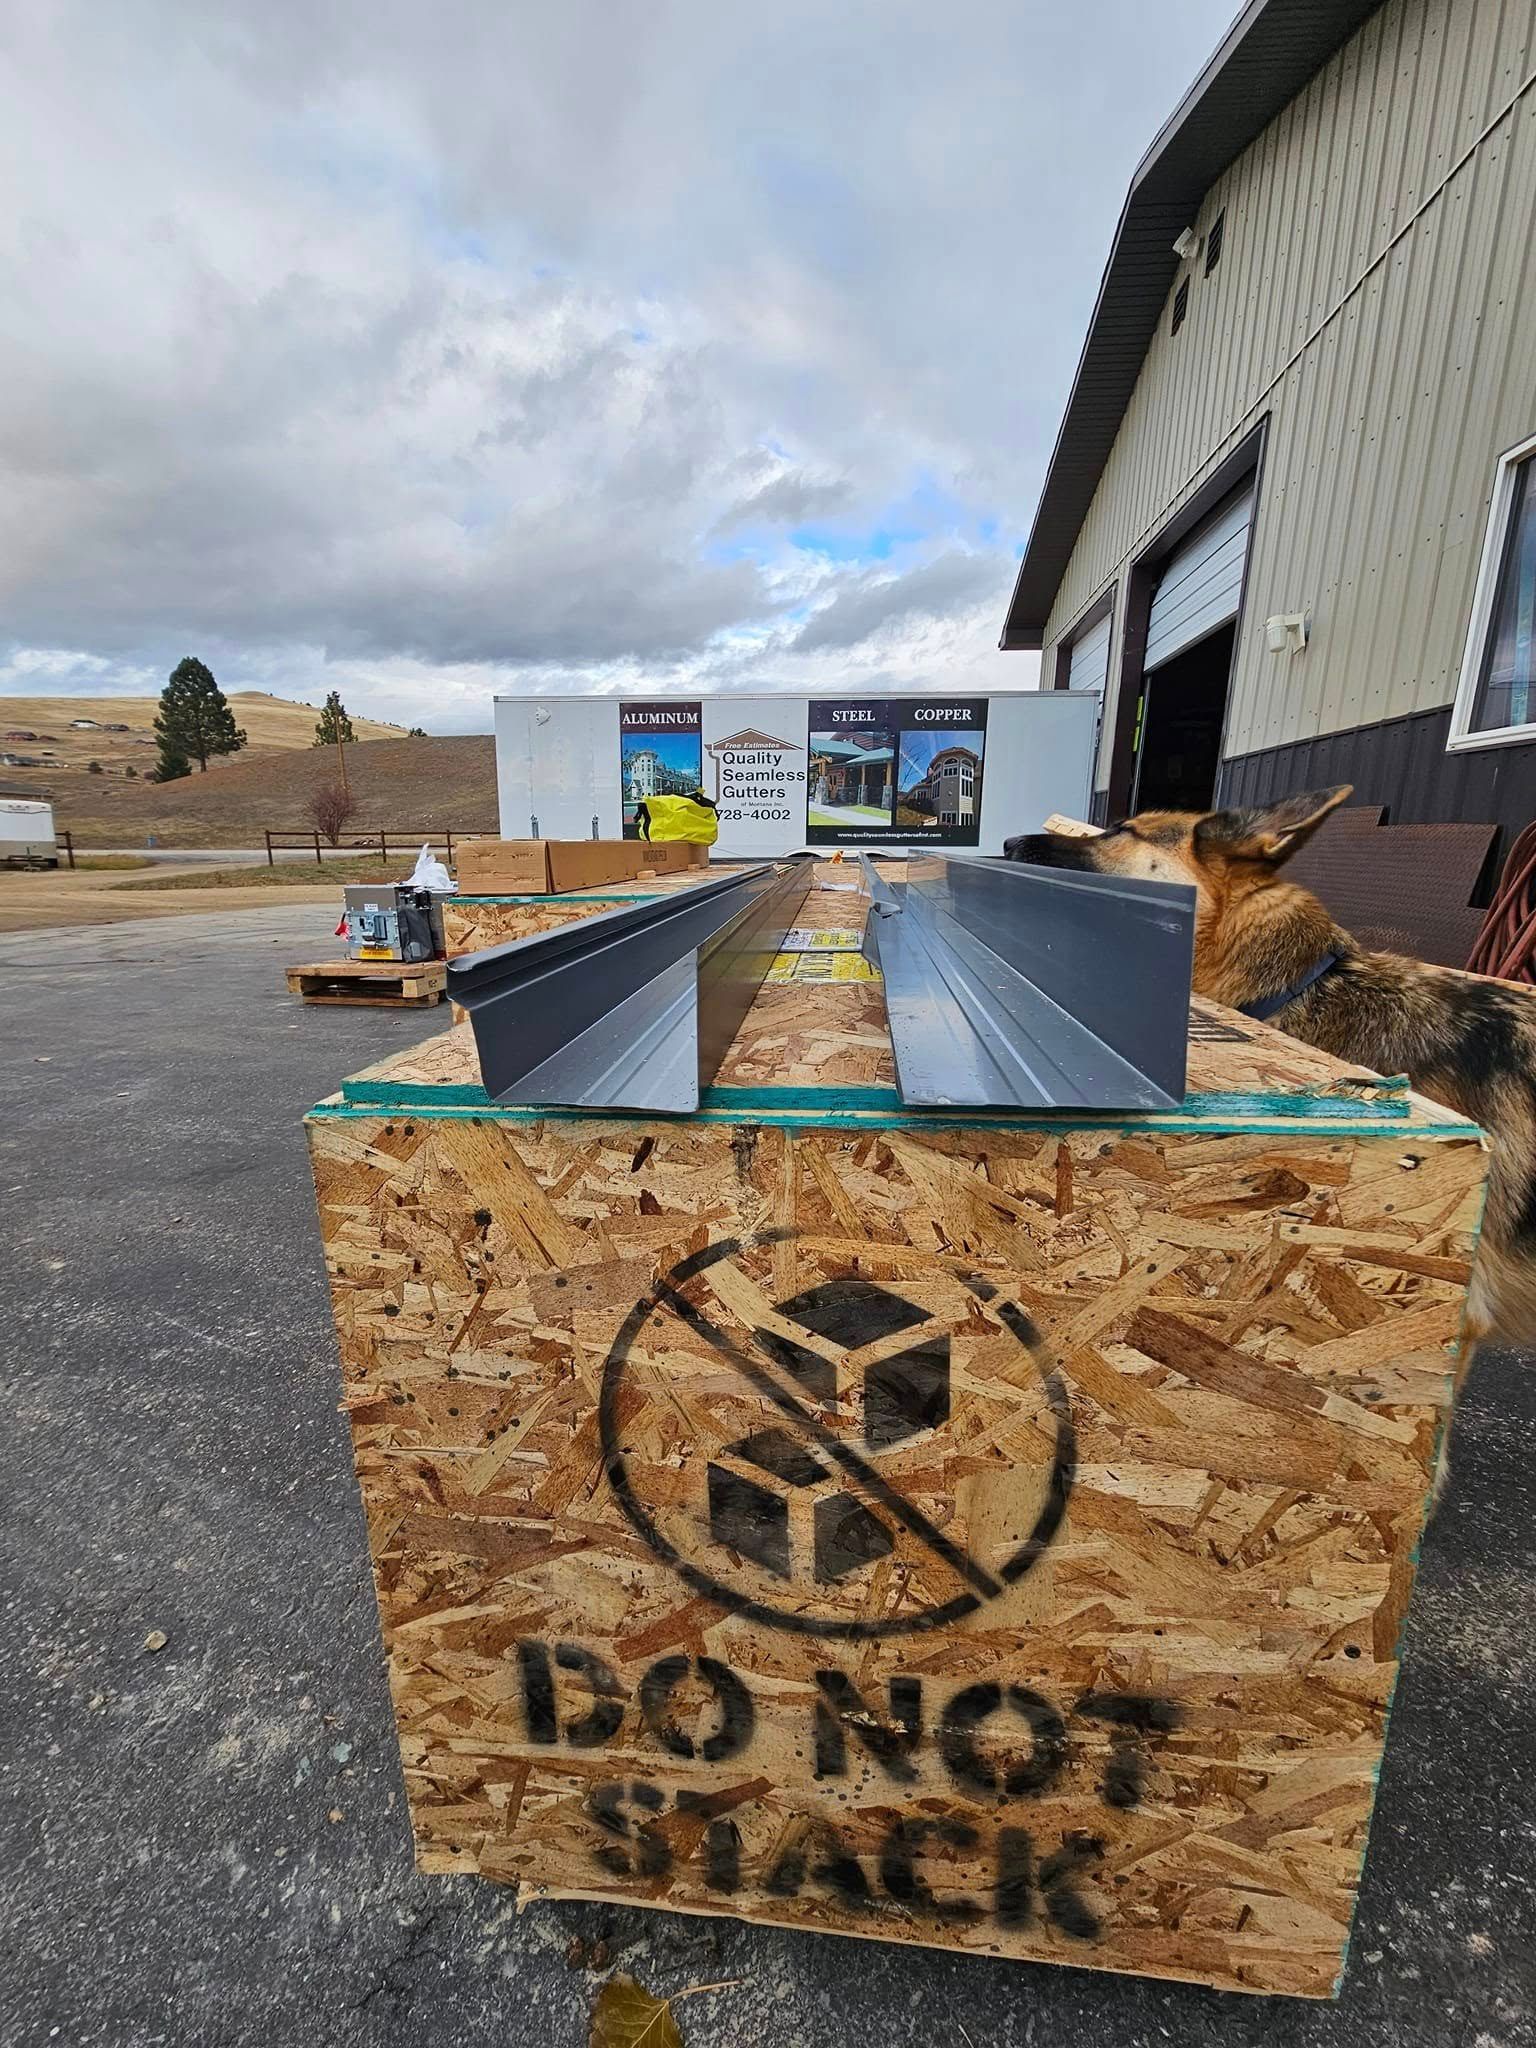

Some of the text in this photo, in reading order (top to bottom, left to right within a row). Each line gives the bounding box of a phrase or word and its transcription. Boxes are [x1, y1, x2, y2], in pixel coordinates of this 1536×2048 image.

[622, 713, 699, 724] ALUMINUM
[832, 710, 875, 722] STEEL
[914, 708, 972, 721] COPPER
[722, 751, 782, 766] Quality
[722, 768, 805, 781] Seamless
[722, 785, 786, 798] Gutters
[717, 809, 791, 820] 728-4002
[516, 1638, 1184, 1809] DO NOT
[588, 1779, 1113, 1940] STACK
